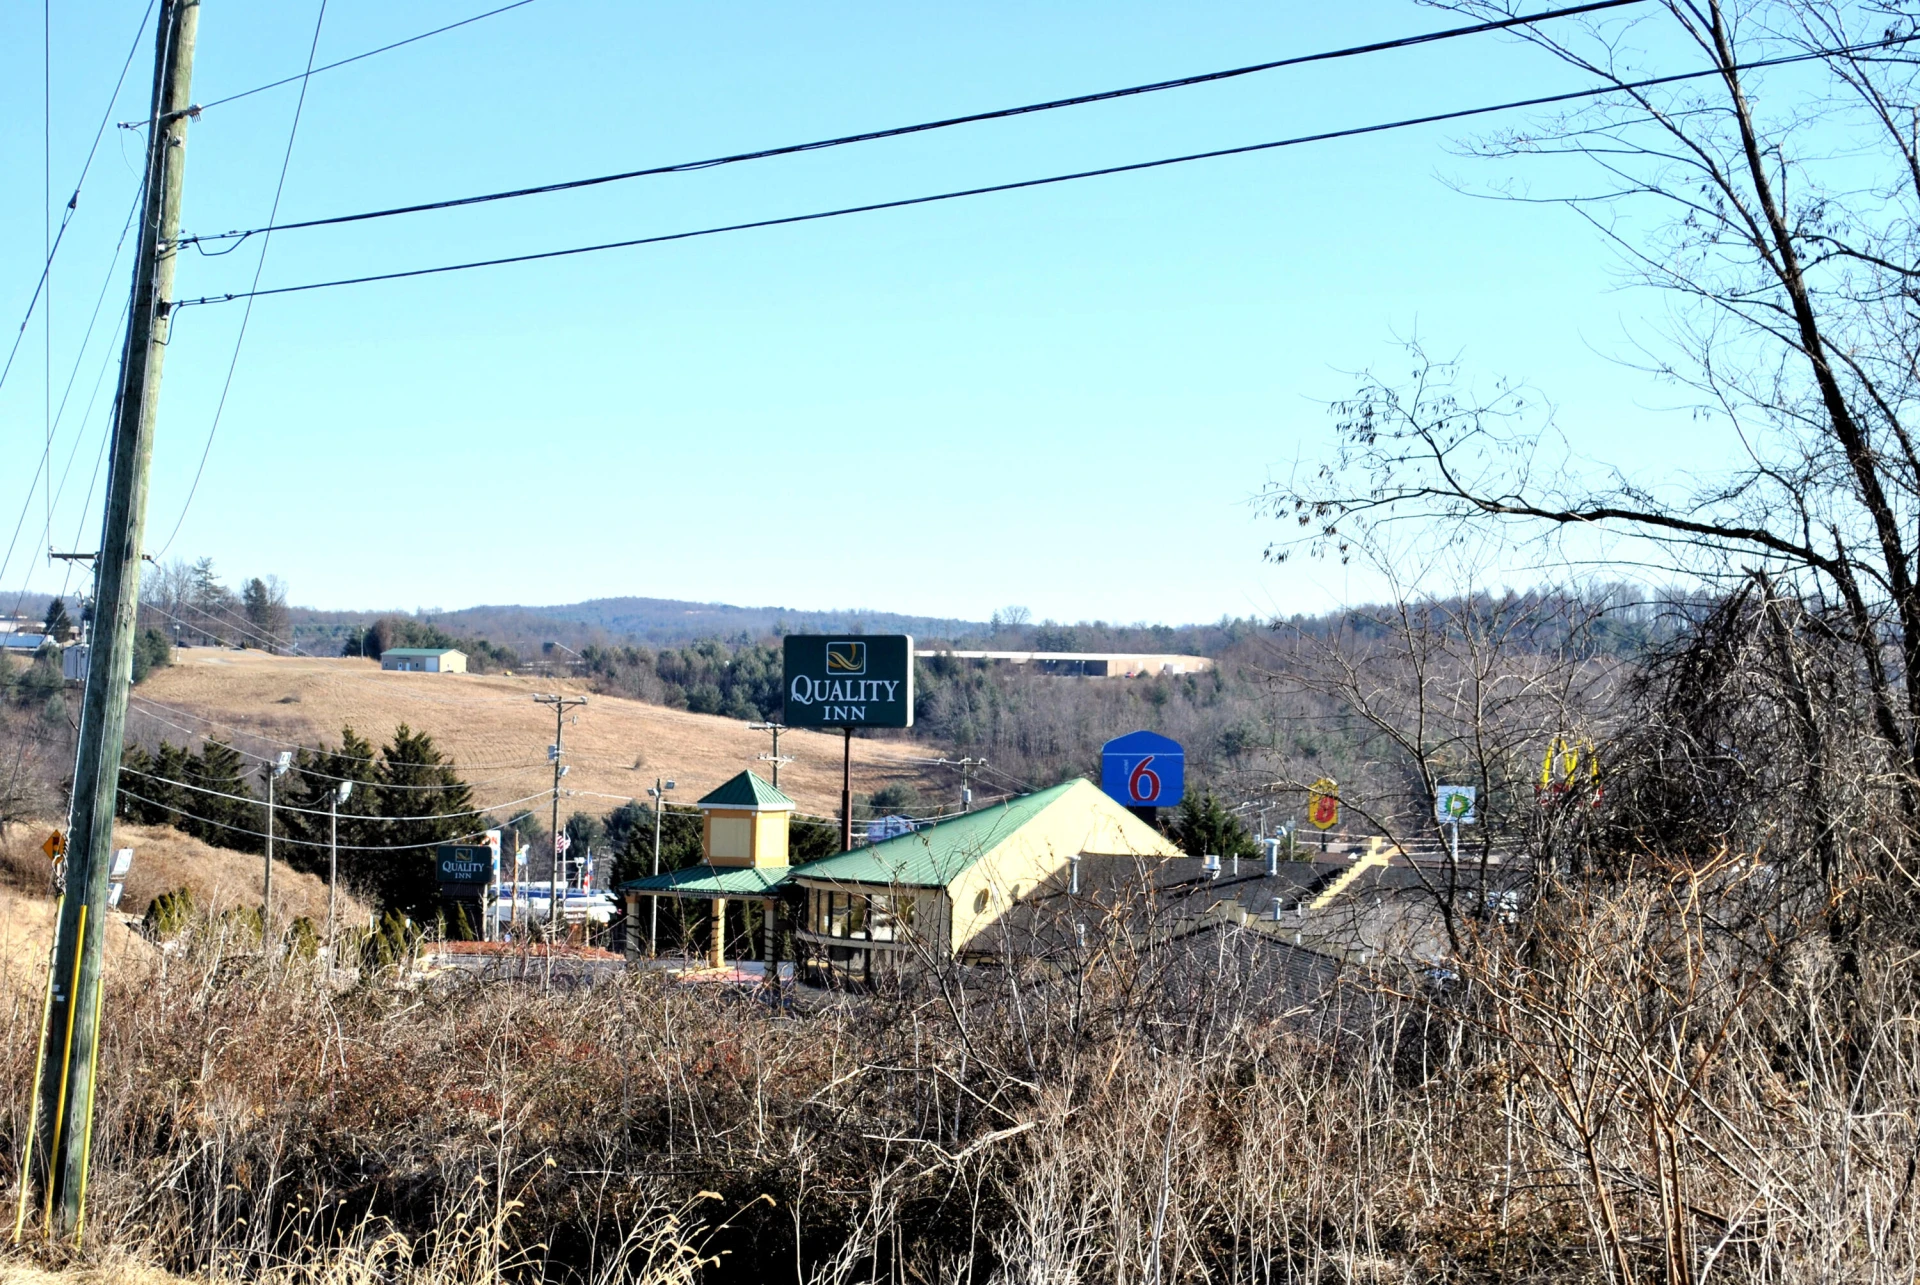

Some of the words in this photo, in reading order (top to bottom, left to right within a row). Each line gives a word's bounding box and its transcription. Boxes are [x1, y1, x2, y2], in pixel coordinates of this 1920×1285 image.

[791, 674, 899, 705] QUALITY
[823, 706, 866, 720] INN
[1128, 755, 1161, 802] 6
[442, 860, 485, 873] QUALITY
